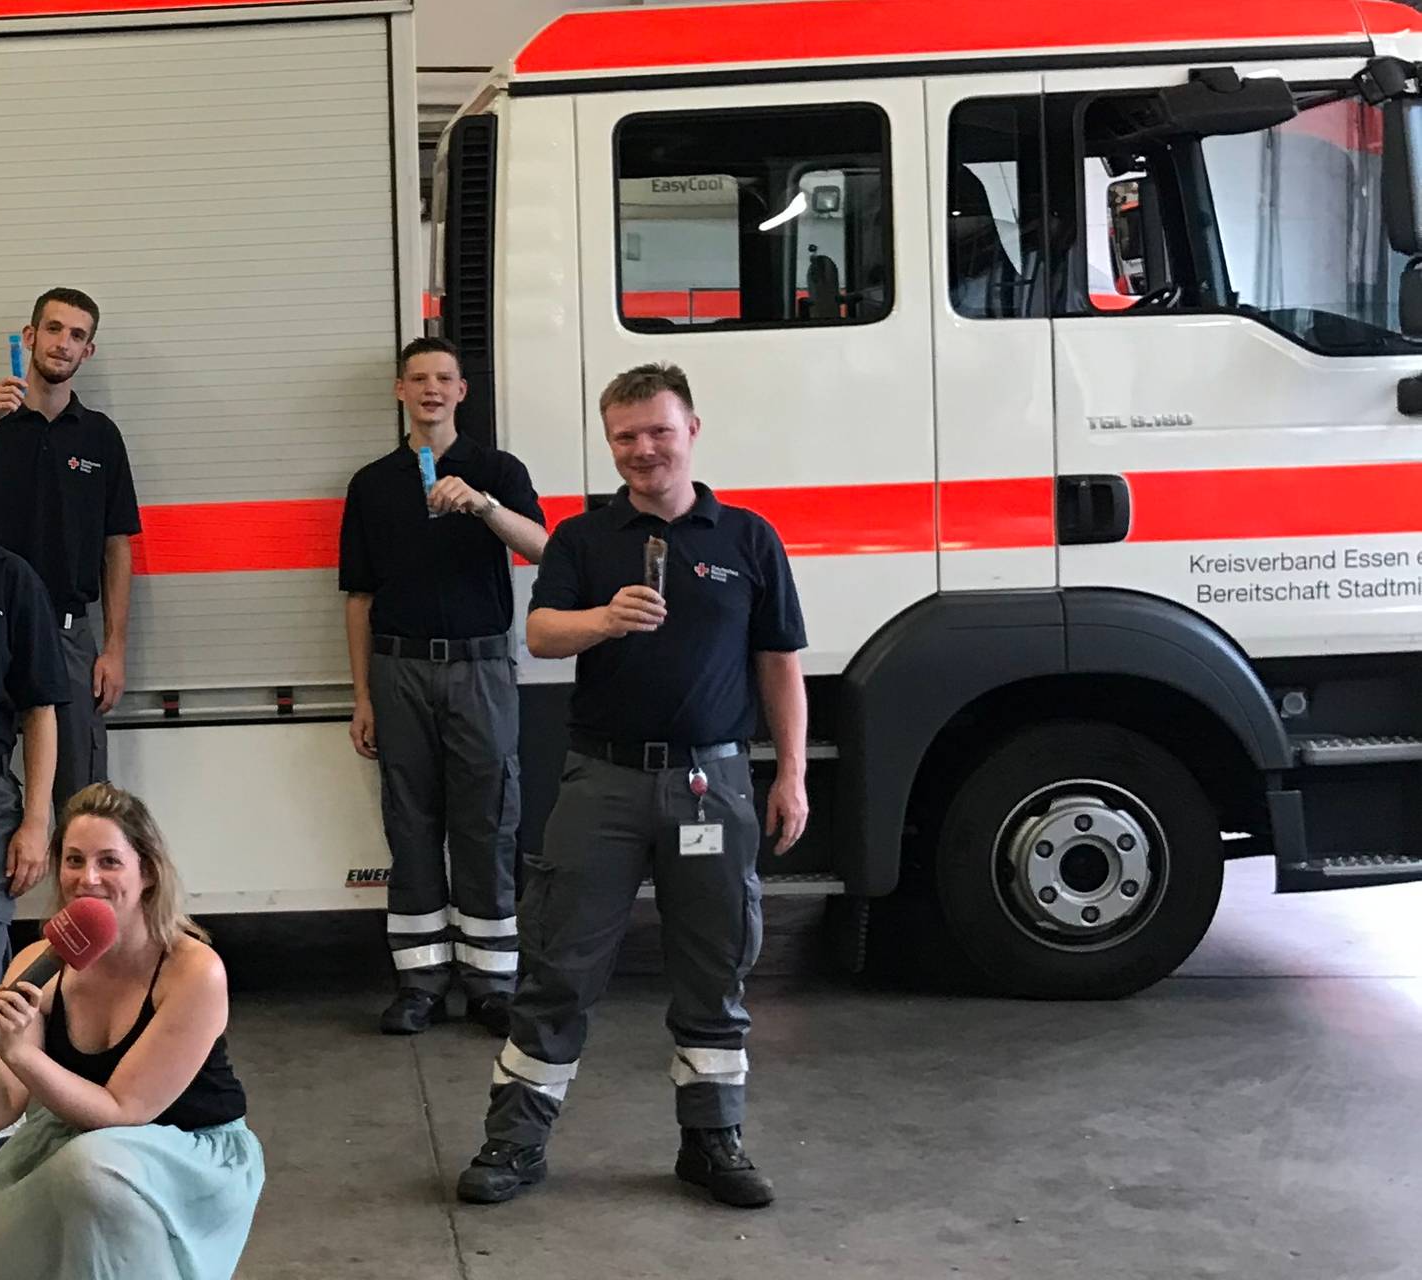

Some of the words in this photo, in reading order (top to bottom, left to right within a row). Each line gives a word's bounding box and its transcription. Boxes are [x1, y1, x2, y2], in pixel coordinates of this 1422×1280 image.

[651, 176, 724, 193] EasyCool
[1189, 551, 1337, 574] Kreisverband
[1344, 549, 1409, 569] Essen
[1197, 580, 1331, 604] Bereitschaft
[1338, 576, 1422, 600] Stadtmi
